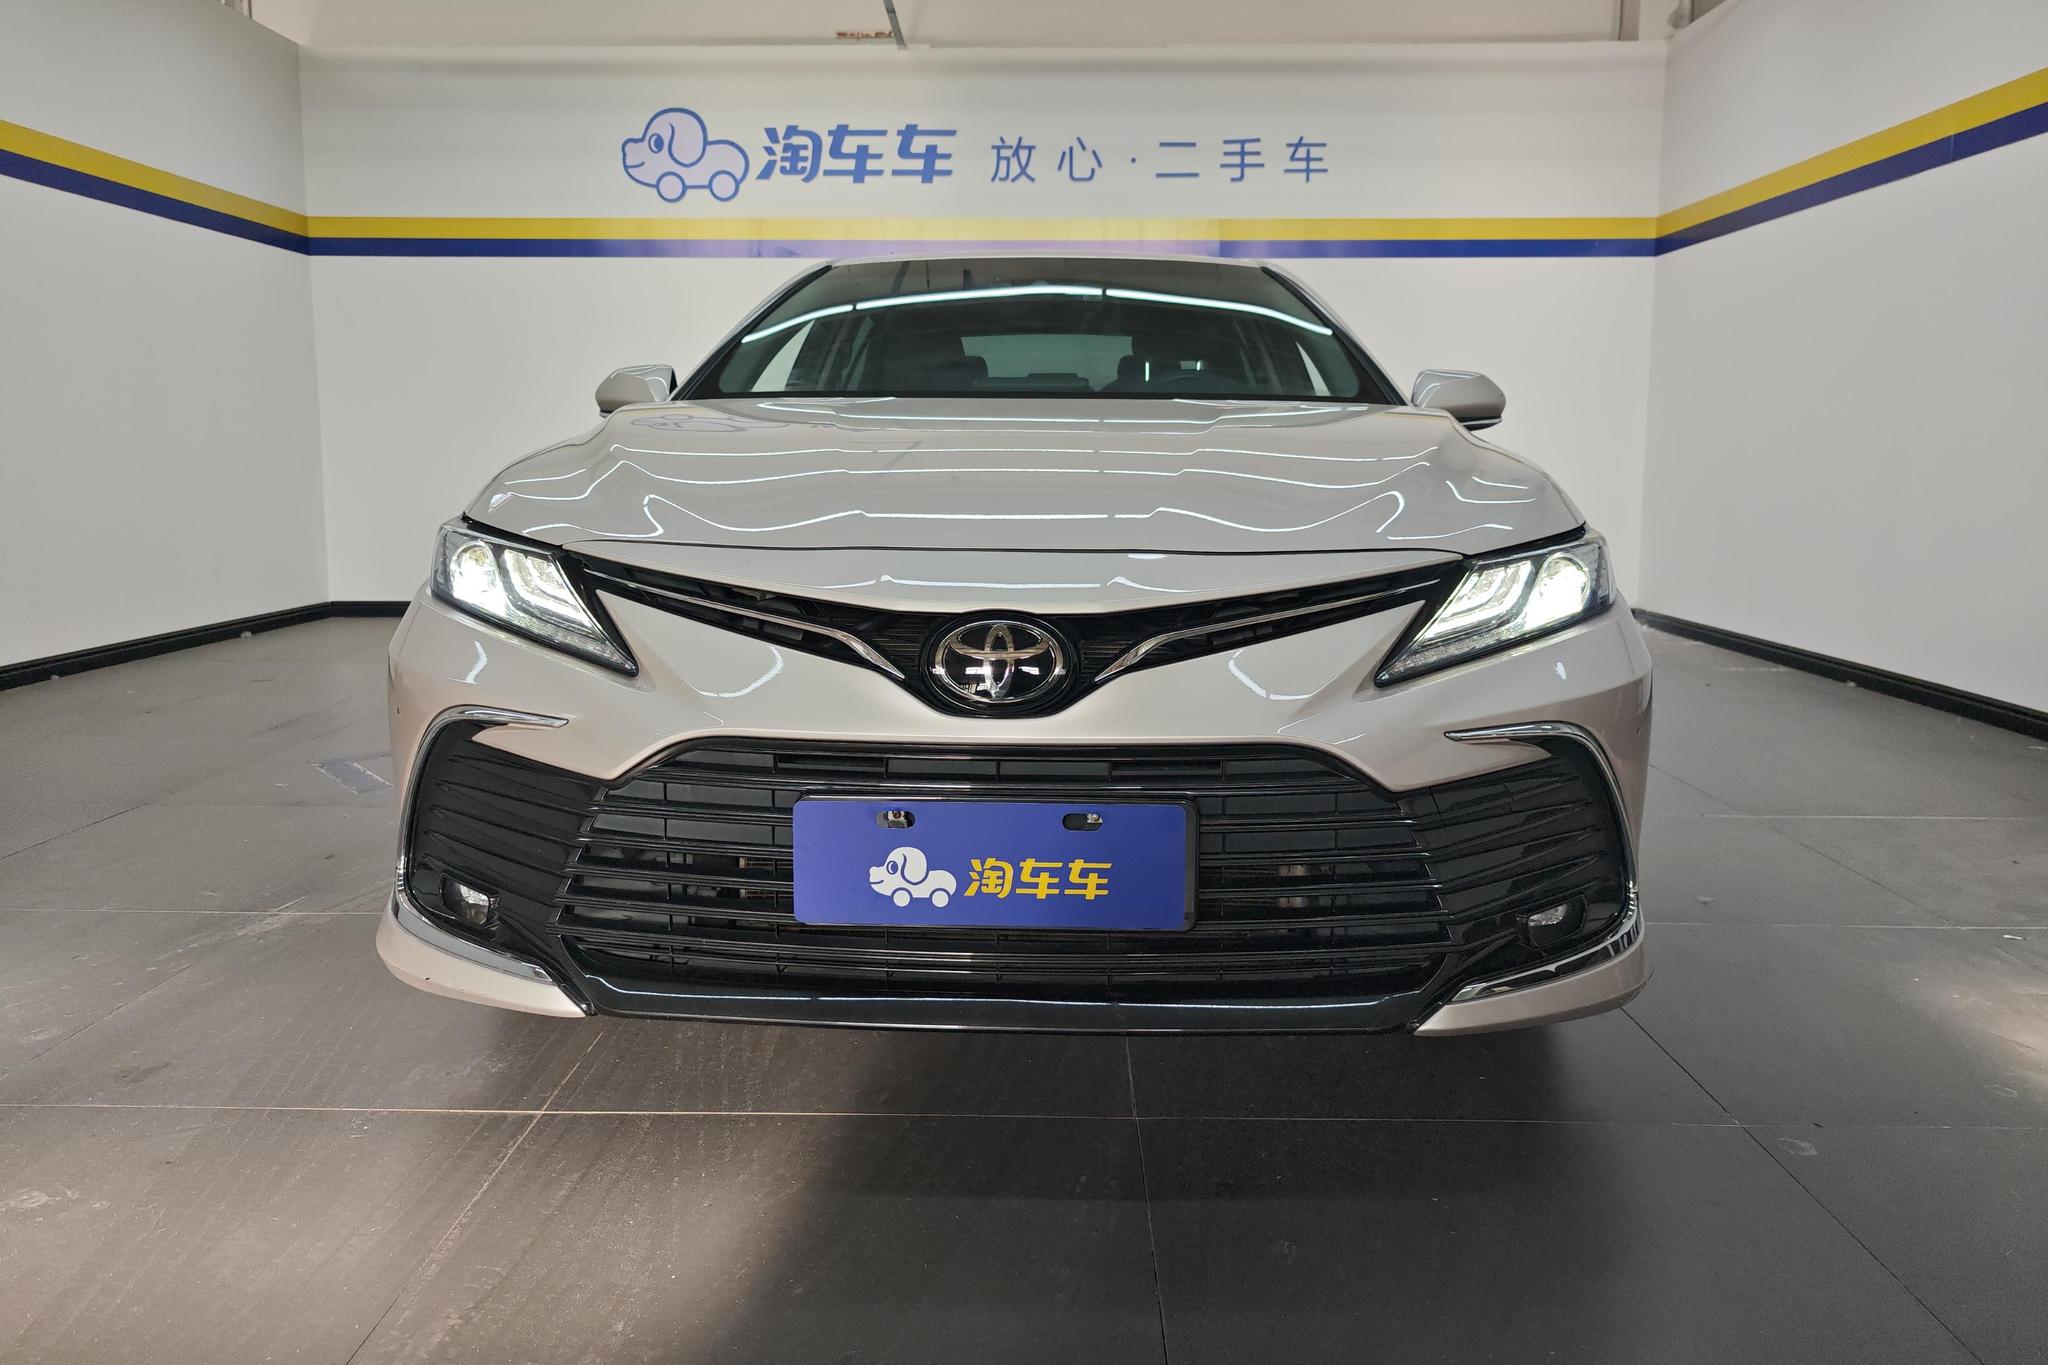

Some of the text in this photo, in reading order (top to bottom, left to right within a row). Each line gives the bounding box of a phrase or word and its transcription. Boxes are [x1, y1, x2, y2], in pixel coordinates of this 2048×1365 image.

[756, 123, 957, 184] 淘车车
[964, 857, 1113, 901] 淘车车
